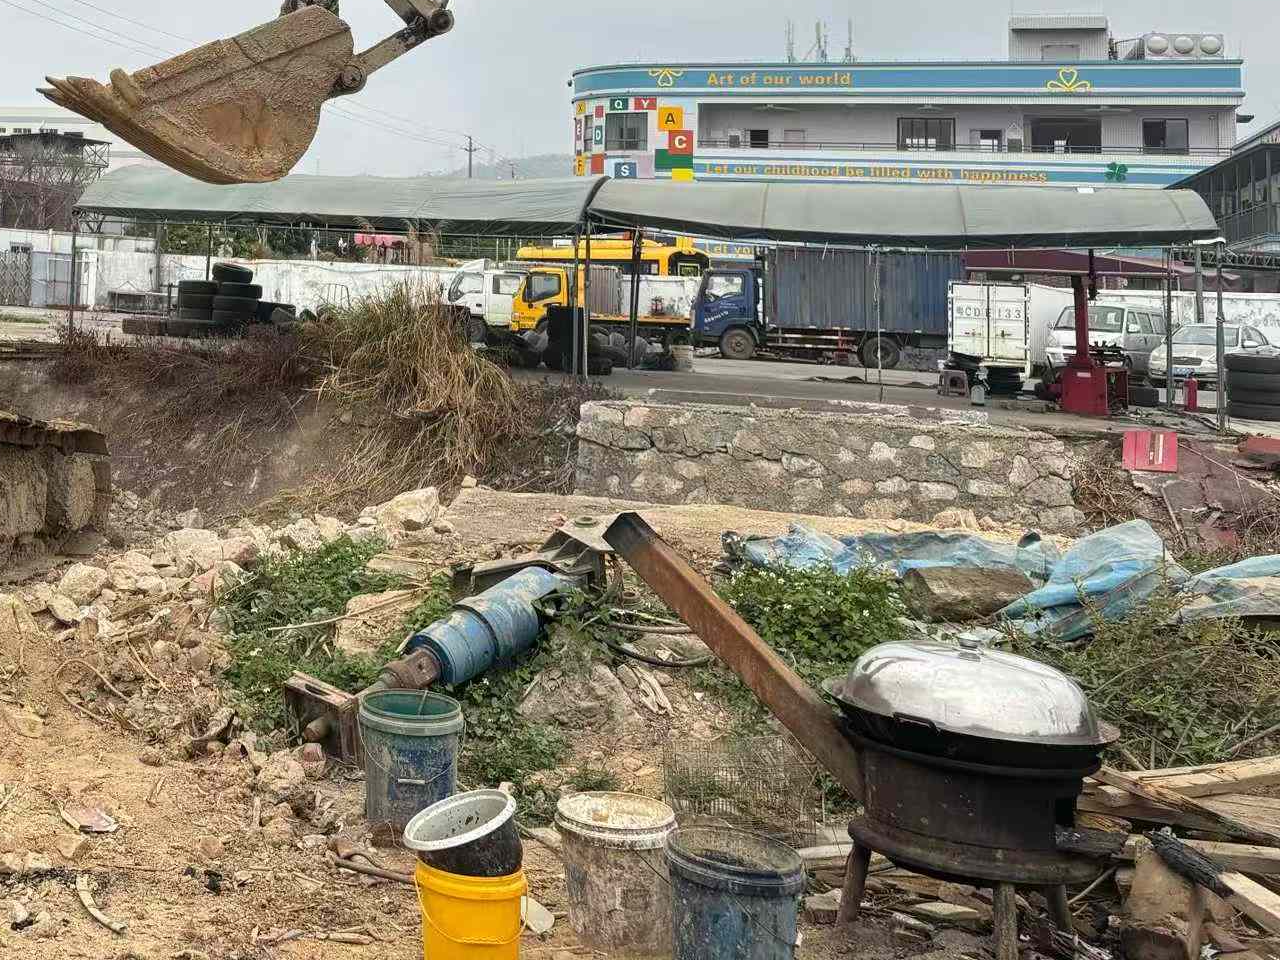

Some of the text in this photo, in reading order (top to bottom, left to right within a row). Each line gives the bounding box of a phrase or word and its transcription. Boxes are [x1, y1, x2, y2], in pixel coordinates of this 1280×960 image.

[707, 72, 851, 85] Art of our world
[664, 112, 676, 125] A
[674, 135, 687, 149] C
[620, 165, 630, 176] S
